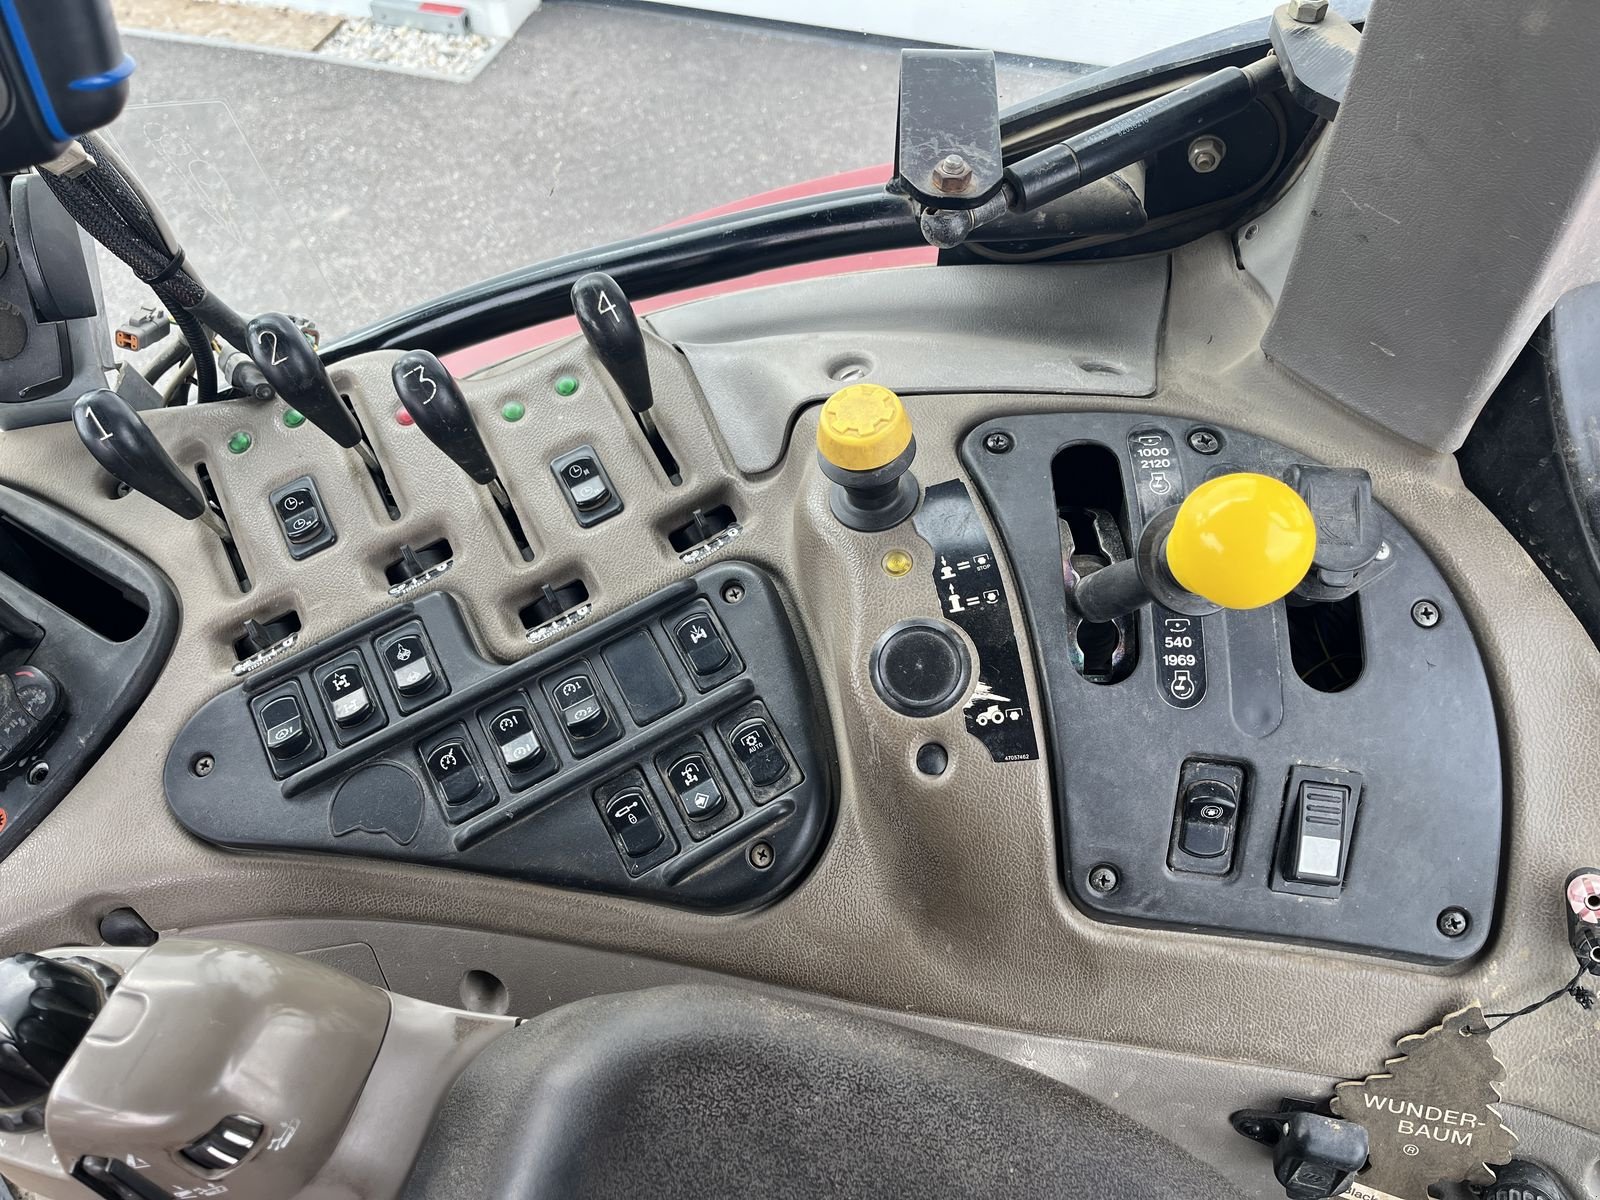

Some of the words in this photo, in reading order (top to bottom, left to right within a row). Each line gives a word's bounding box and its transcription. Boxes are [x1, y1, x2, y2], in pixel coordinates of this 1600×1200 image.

[597, 290, 620, 323] 4
[258, 330, 289, 366] 2
[402, 364, 437, 405] 3
[84, 406, 114, 441] 1
[1137, 447, 1169, 457] 1000
[1140, 458, 1171, 469] 2120
[976, 563, 991, 572] STOP
[1164, 636, 1193, 649] 540
[1162, 654, 1196, 667] 1969
[748, 742, 764, 755] AUTO
[1363, 1093, 1486, 1129] WUNDER-
[1397, 1119, 1473, 1147] BAUM
